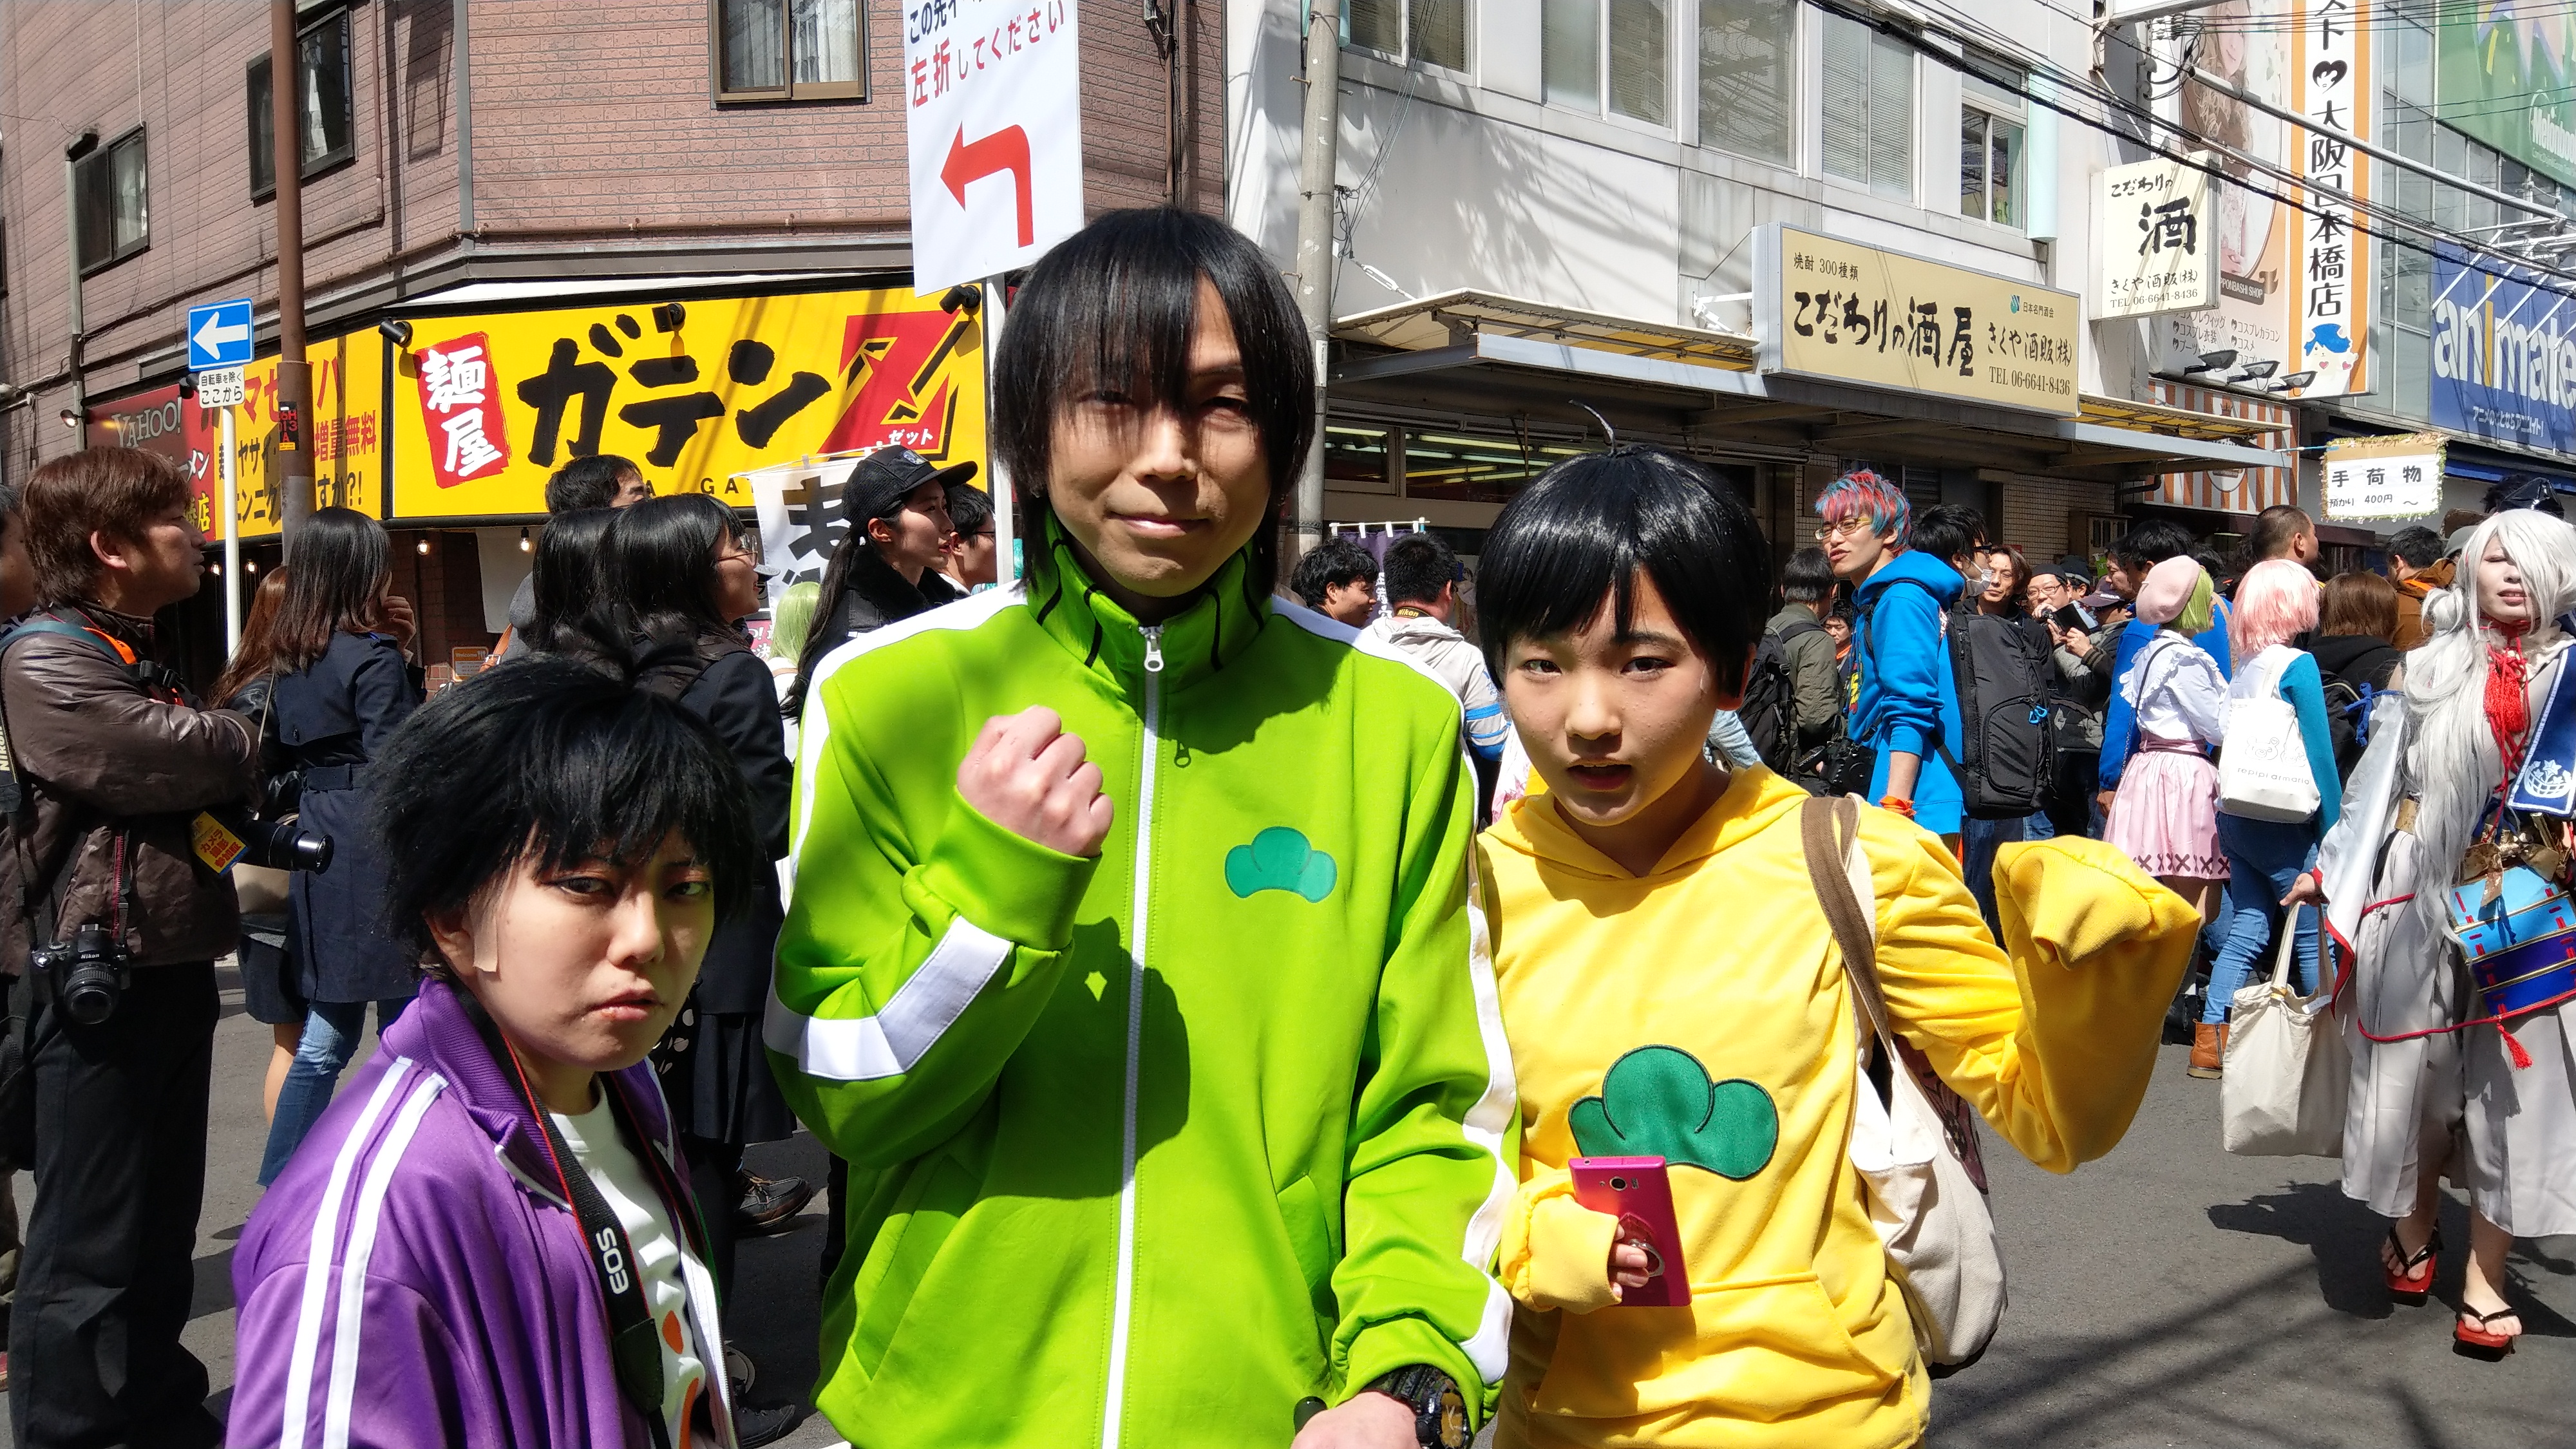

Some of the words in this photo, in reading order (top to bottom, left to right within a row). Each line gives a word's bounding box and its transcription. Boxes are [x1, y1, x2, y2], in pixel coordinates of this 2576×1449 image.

[911, 0, 1063, 109] 左折してください
[2532, 106, 2576, 165] Melonboo
[2111, 173, 2173, 197] こだわりの
[2308, 100, 2347, 318] 大阪日本橋店
[2138, 196, 2197, 256] 酒
[1794, 252, 1814, 272] 焼酎
[1819, 258, 1859, 282] 300種類
[2110, 298, 2130, 308] TEL
[2134, 289, 2197, 305] 06-6641-8436
[2249, 286, 2263, 299] SHOP
[2023, 301, 2054, 318] 日本名門酒会
[2180, 323, 2217, 345] コスプレ衣装
[2238, 321, 2280, 343] コスプレカラコン
[2434, 274, 2576, 410] animate
[2238, 338, 2255, 352] コスメ
[201, 371, 242, 386] 自転車を除く
[1989, 366, 2008, 385] TEL
[2011, 370, 2070, 396] 06-6641-8436
[202, 386, 243, 404] ここから
[518, 314, 831, 470] ガテン
[111, 394, 183, 448] YAHOO!
[421, 345, 504, 478] 麺屋
[314, 410, 376, 462] 増量無料
[888, 428, 933, 446] ゼット
[177, 448, 211, 482] ーメン
[701, 477, 739, 495] GA
[2329, 498, 2354, 508] 預かり
[2364, 494, 2393, 504] 400円
[1397, 608, 1419, 618] Nikon
[2237, 768, 2268, 778] repipi
[2271, 774, 2309, 785] armario
[200, 828, 223, 853] カメラ
[596, 1227, 629, 1294] EOS
